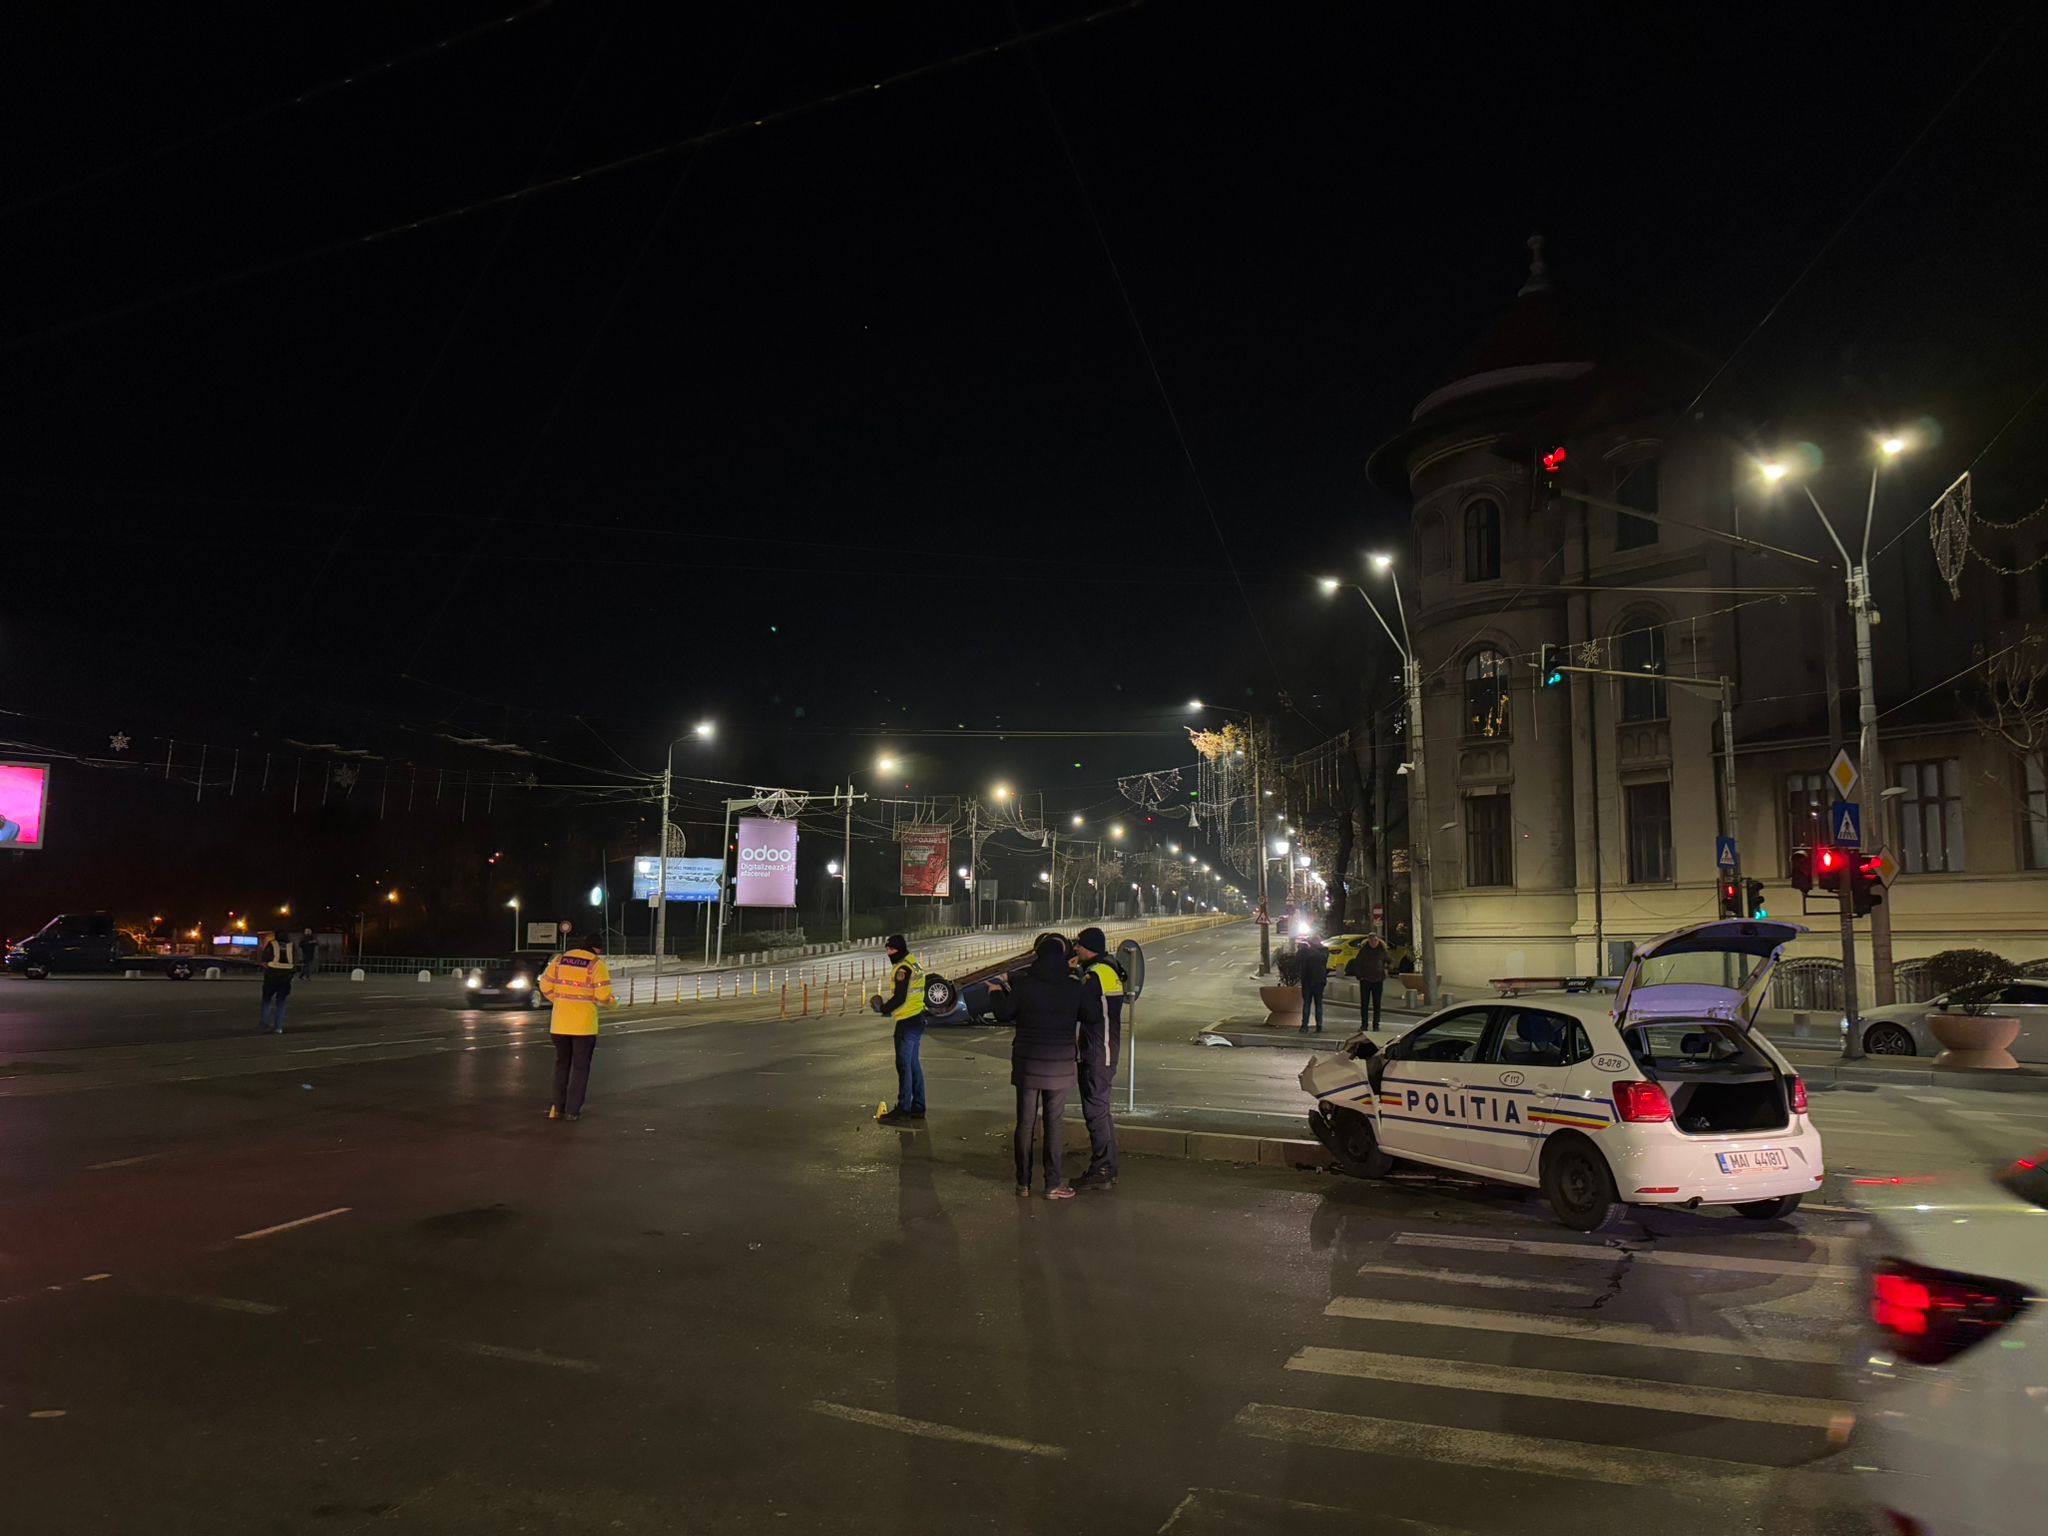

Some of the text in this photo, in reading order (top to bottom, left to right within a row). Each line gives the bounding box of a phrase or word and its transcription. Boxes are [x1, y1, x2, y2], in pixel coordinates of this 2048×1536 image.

[742, 845, 791, 862] odoo
[1598, 1058, 1622, 1068] B-078
[1407, 1090, 1520, 1124] POLITIA
[1729, 1151, 1782, 1168] MAI 44181
